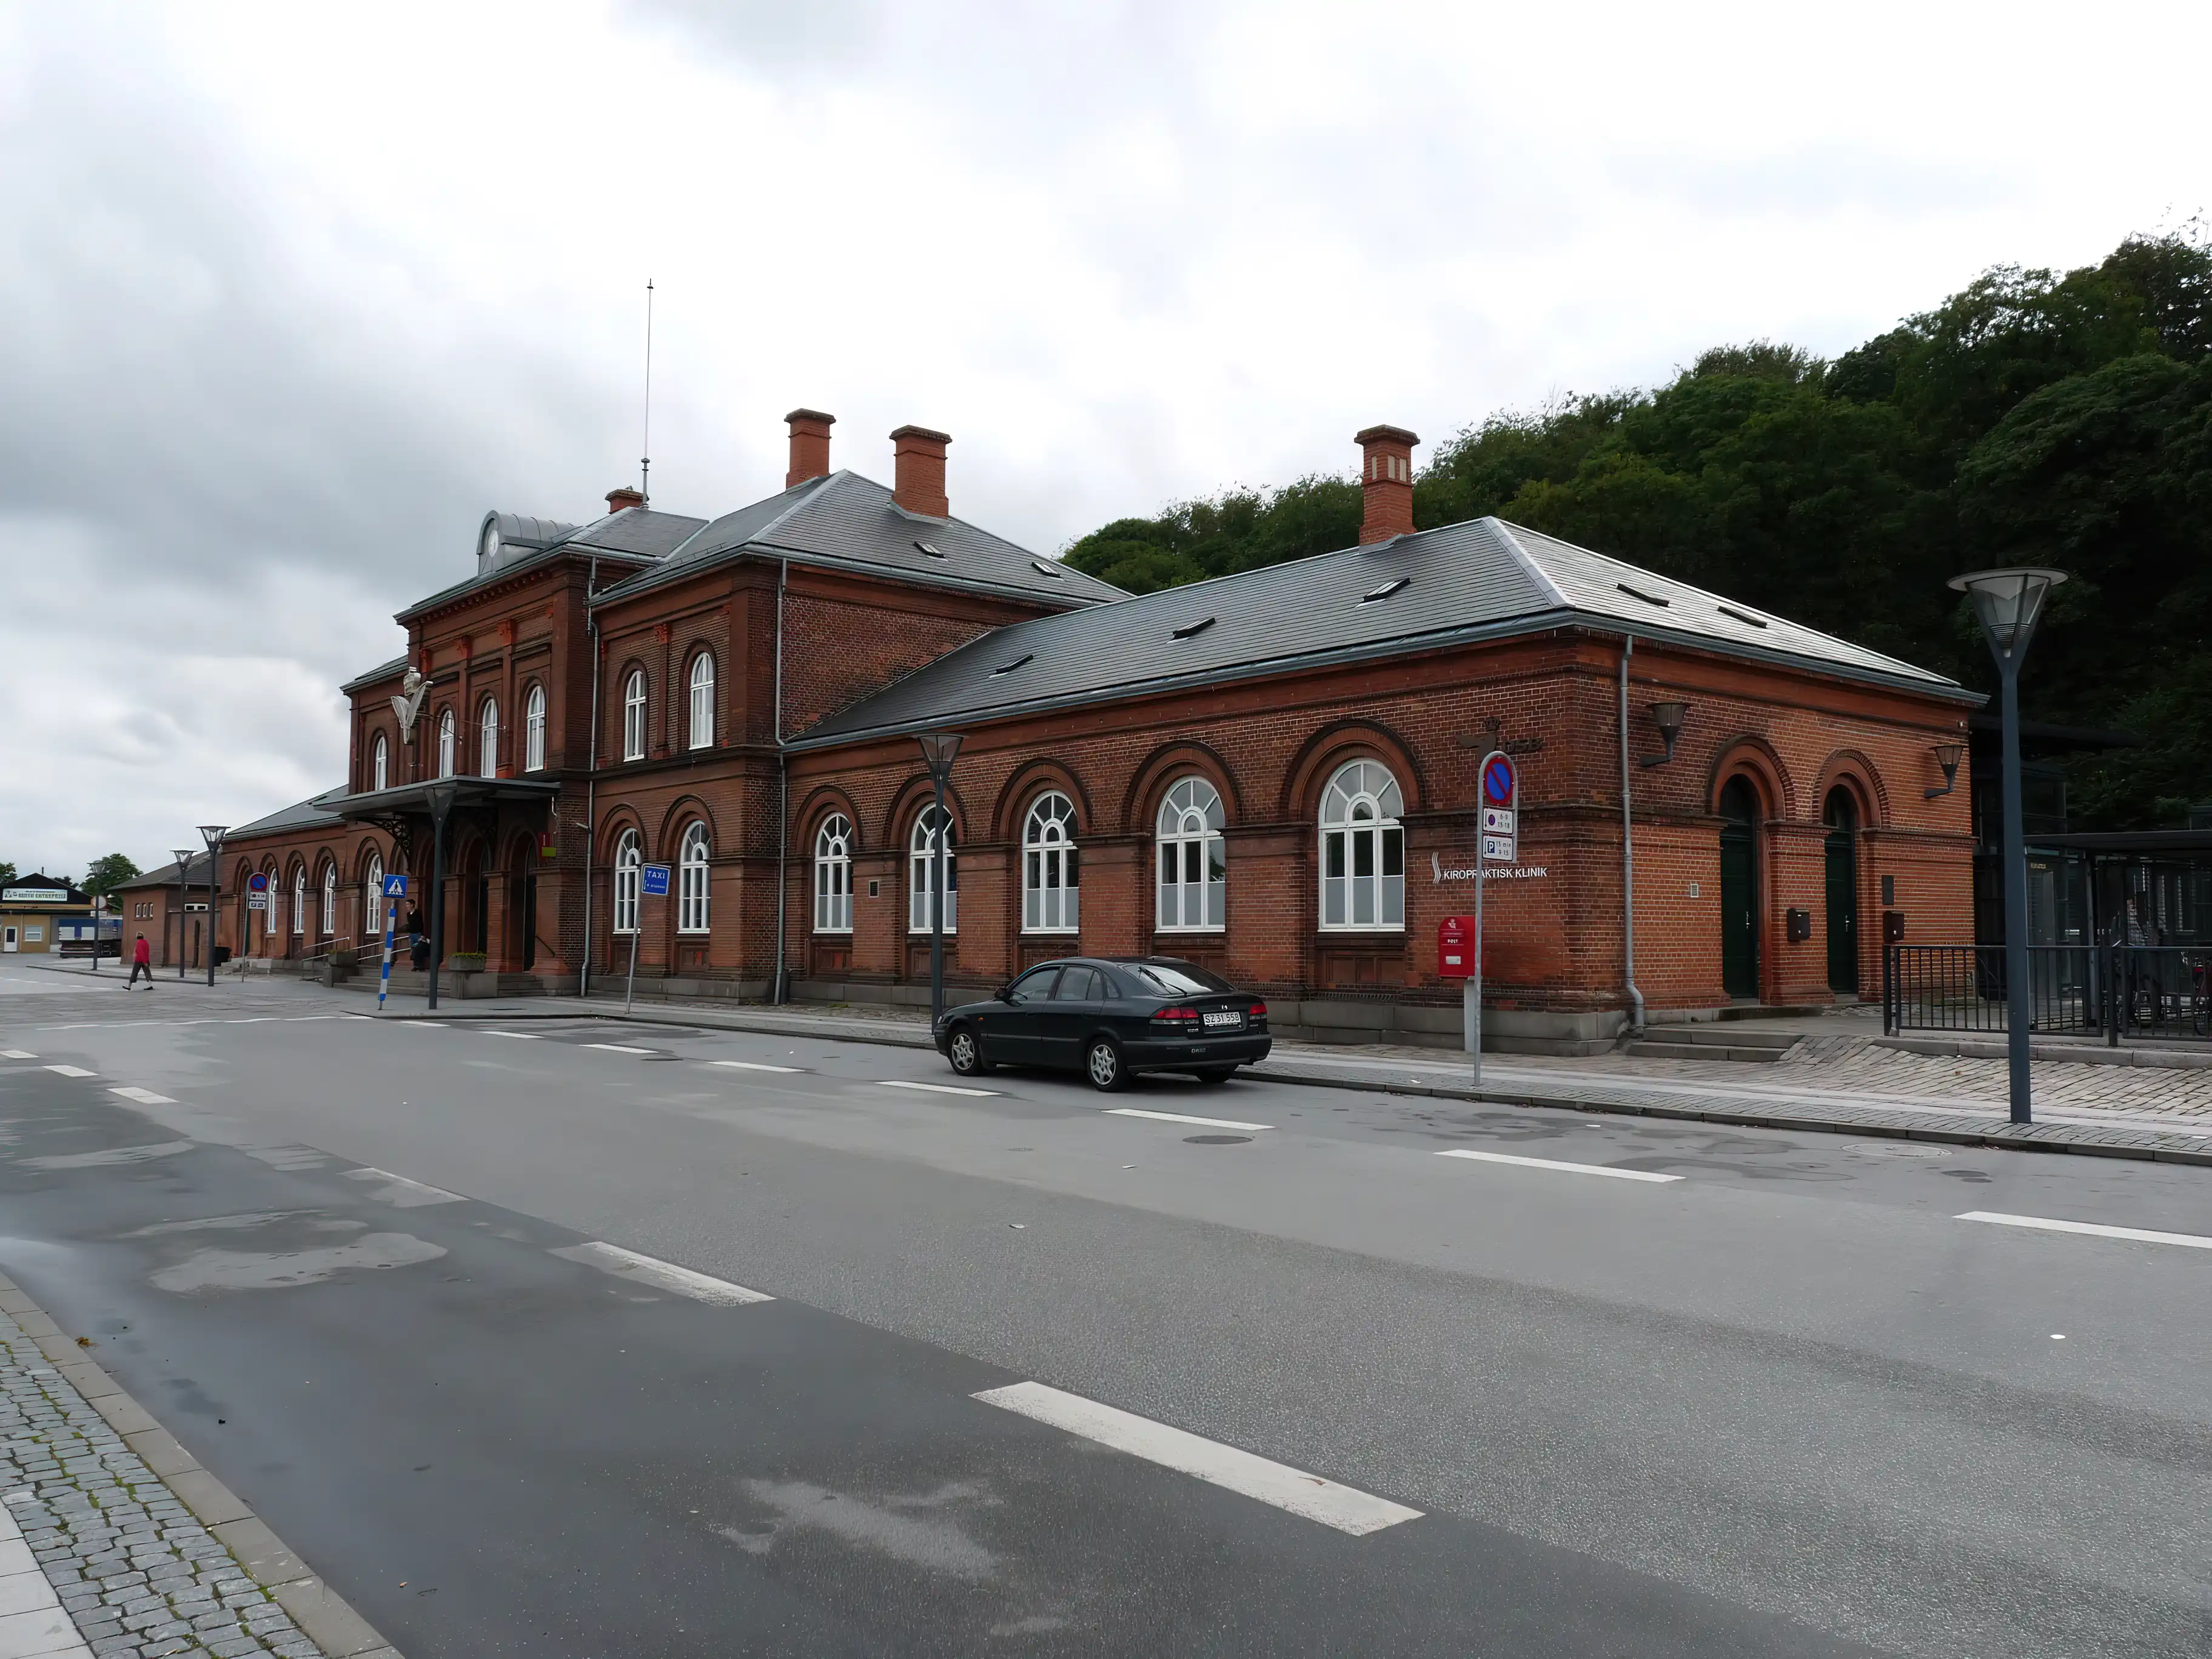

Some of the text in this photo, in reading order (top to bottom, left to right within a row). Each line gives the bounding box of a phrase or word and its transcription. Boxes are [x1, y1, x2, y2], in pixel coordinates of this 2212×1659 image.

[1504, 738, 1542, 752] DSB
[646, 871, 665, 879] TAXI
[1515, 866, 1547, 878] KLINIK
[1205, 1013, 1239, 1024] SZ 31 558
